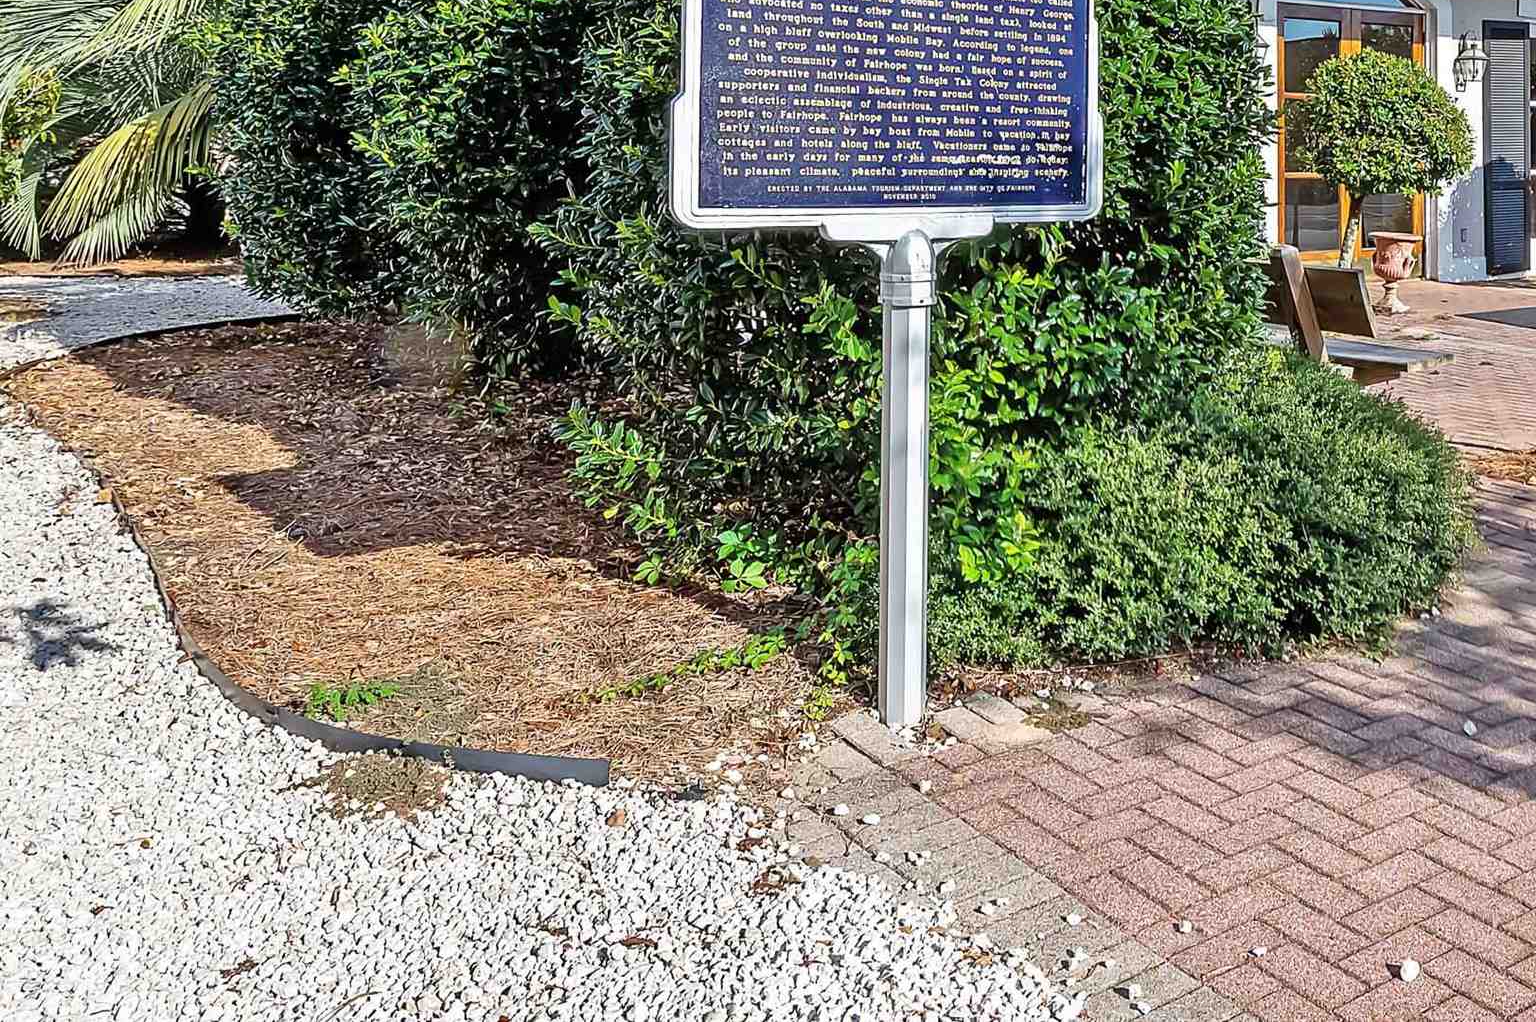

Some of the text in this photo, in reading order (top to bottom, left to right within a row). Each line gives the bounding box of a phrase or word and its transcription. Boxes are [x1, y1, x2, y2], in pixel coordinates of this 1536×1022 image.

[726, 7, 751, 18] land
[832, 16, 848, 25] the
[855, 18, 884, 28] South
[959, 26, 988, 36] before
[810, 2, 822, 10] no
[865, 5, 892, 15] other
[941, 12, 968, 24] single
[975, 14, 993, 24] land
[1029, 19, 1056, 29] looked
[993, 4, 1003, 12] of
[1008, 5, 1034, 17] Henry
[718, 23, 732, 31] on
[752, 23, 777, 36] high
[817, 28, 878, 43] overlooking
[886, 33, 918, 44] Mobile
[952, 38, 998, 52] According
[1006, 42, 1015, 50] to
[728, 36, 740, 45] of
[747, 37, 766, 47] the
[775, 41, 807, 52] group
[894, 47, 925, 60] colony
[967, 52, 983, 61] fair
[991, 54, 1011, 65] hope
[1016, 55, 1026, 63] of
[743, 65, 809, 80] cooperative
[896, 74, 911, 82] the
[918, 75, 947, 87] Single
[755, 52, 773, 62] the
[780, 54, 837, 68] community
[845, 57, 856, 66] of
[863, 59, 907, 72] Fairhope
[1057, 70, 1067, 78] of
[718, 78, 779, 92] supporters
[787, 81, 806, 91] and
[912, 87, 936, 96] from
[1037, 93, 1071, 105] drawing
[741, 94, 786, 104] eclectic
[860, 99, 871, 108] of
[940, 102, 979, 112] creative
[717, 107, 754, 120] people
[761, 109, 772, 117] to
[839, 111, 881, 123] Fairhope
[993, 117, 1020, 125] resort
[719, 122, 750, 134] Early
[843, 125, 856, 136] by
[862, 126, 881, 137] bay
[917, 127, 940, 136] from
[982, 129, 992, 137] to
[874, 139, 889, 148] the
[766, 151, 795, 163] early
[834, 152, 850, 161] for
